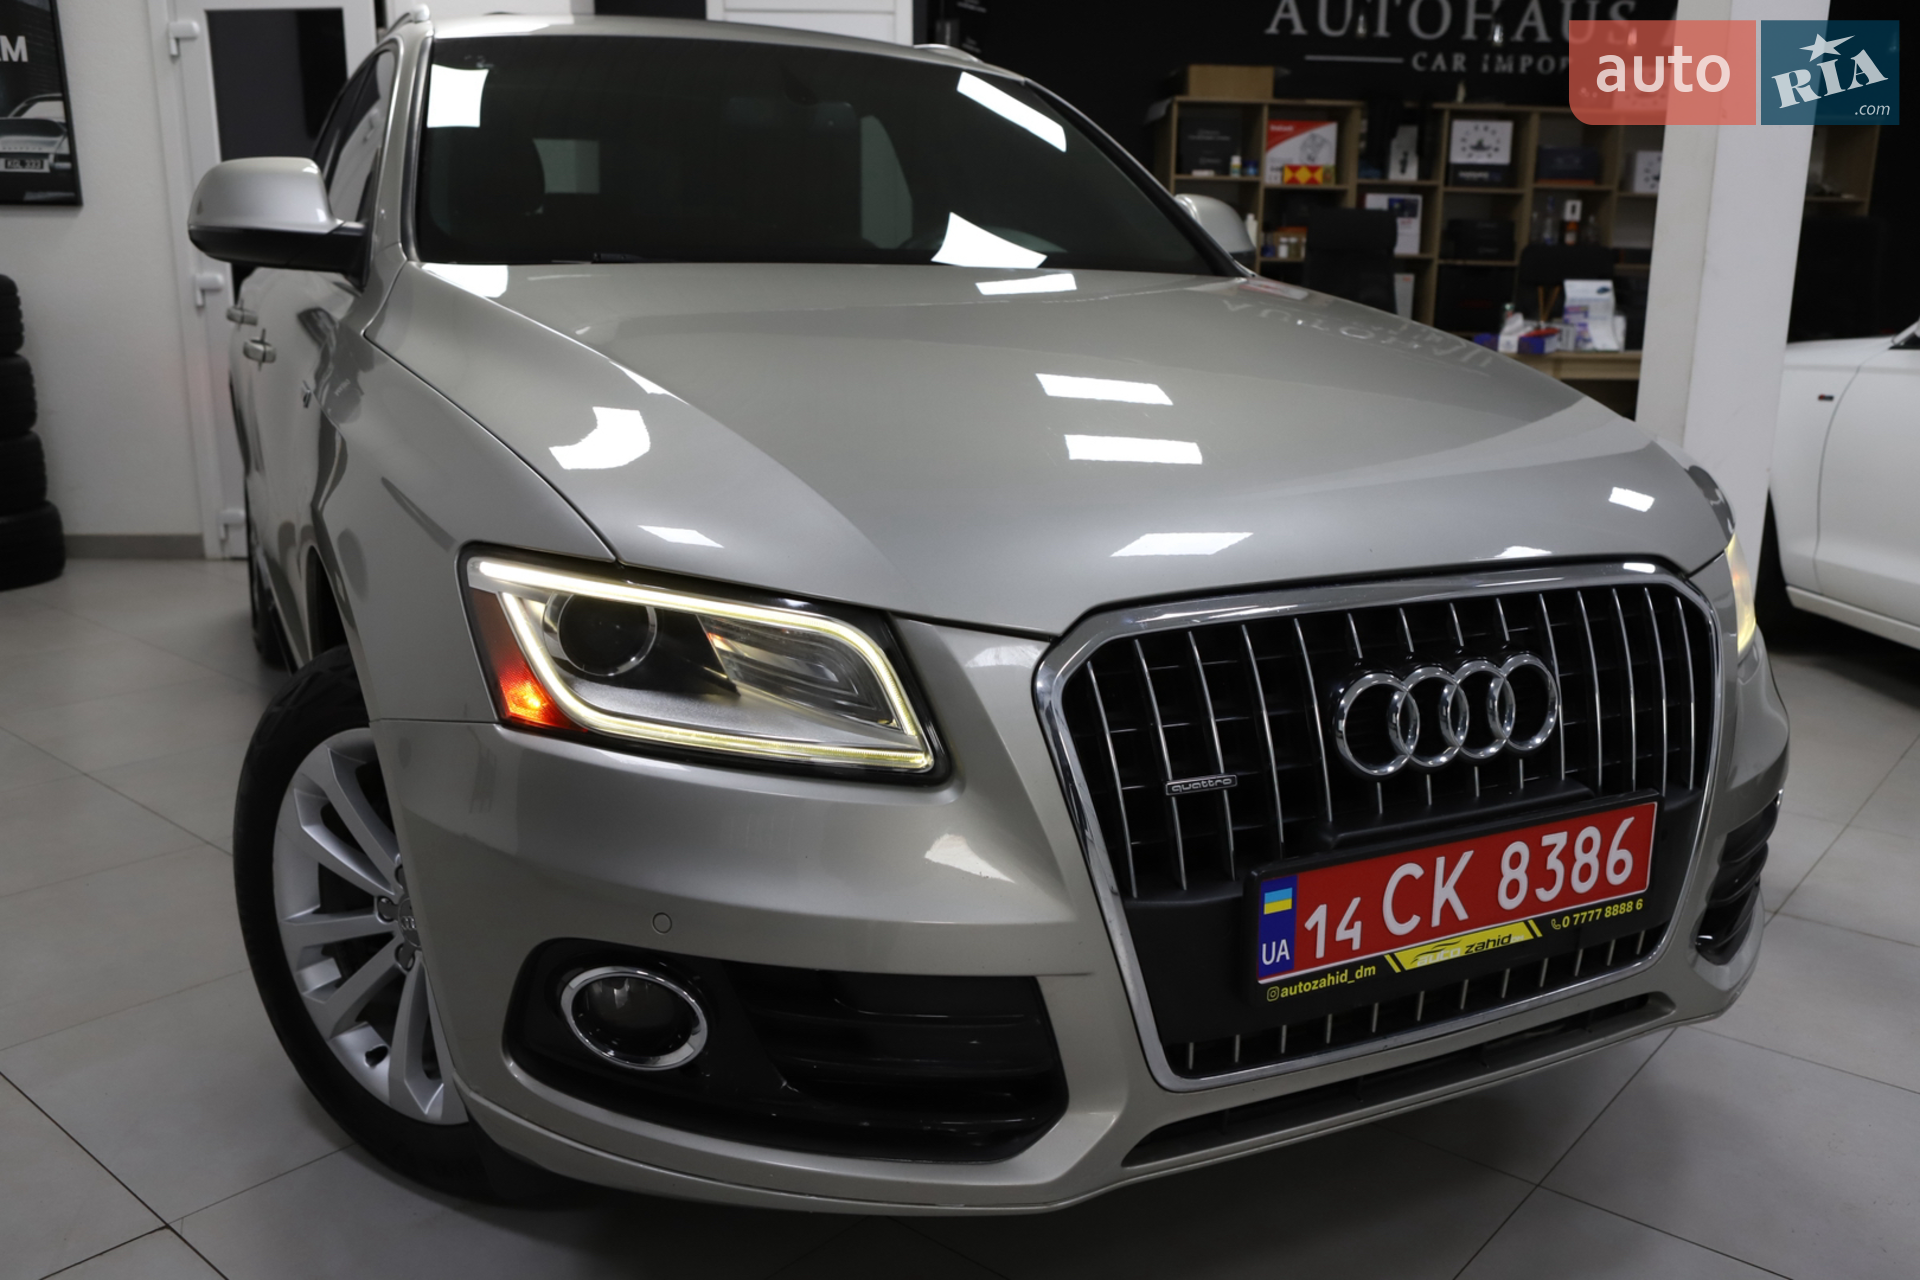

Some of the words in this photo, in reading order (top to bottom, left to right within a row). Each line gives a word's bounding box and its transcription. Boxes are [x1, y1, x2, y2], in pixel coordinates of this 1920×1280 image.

[1264, 0, 1636, 45] AUTOHAUS
[1412, 52, 1467, 73] CAR
[1171, 778, 1233, 793] quattro
[1304, 896, 1362, 959] 14
[1382, 850, 1474, 935] CK
[1497, 816, 1635, 911] 8386
[1562, 916, 1571, 928] 0
[1573, 908, 1603, 926] 7777
[1604, 900, 1634, 918] 8888
[1635, 898, 1644, 911] 6
[1262, 939, 1290, 966] UA
[1416, 946, 1461, 967] auto
[1465, 934, 1512, 955] zahid
[1280, 965, 1377, 998] autozahid_dm
